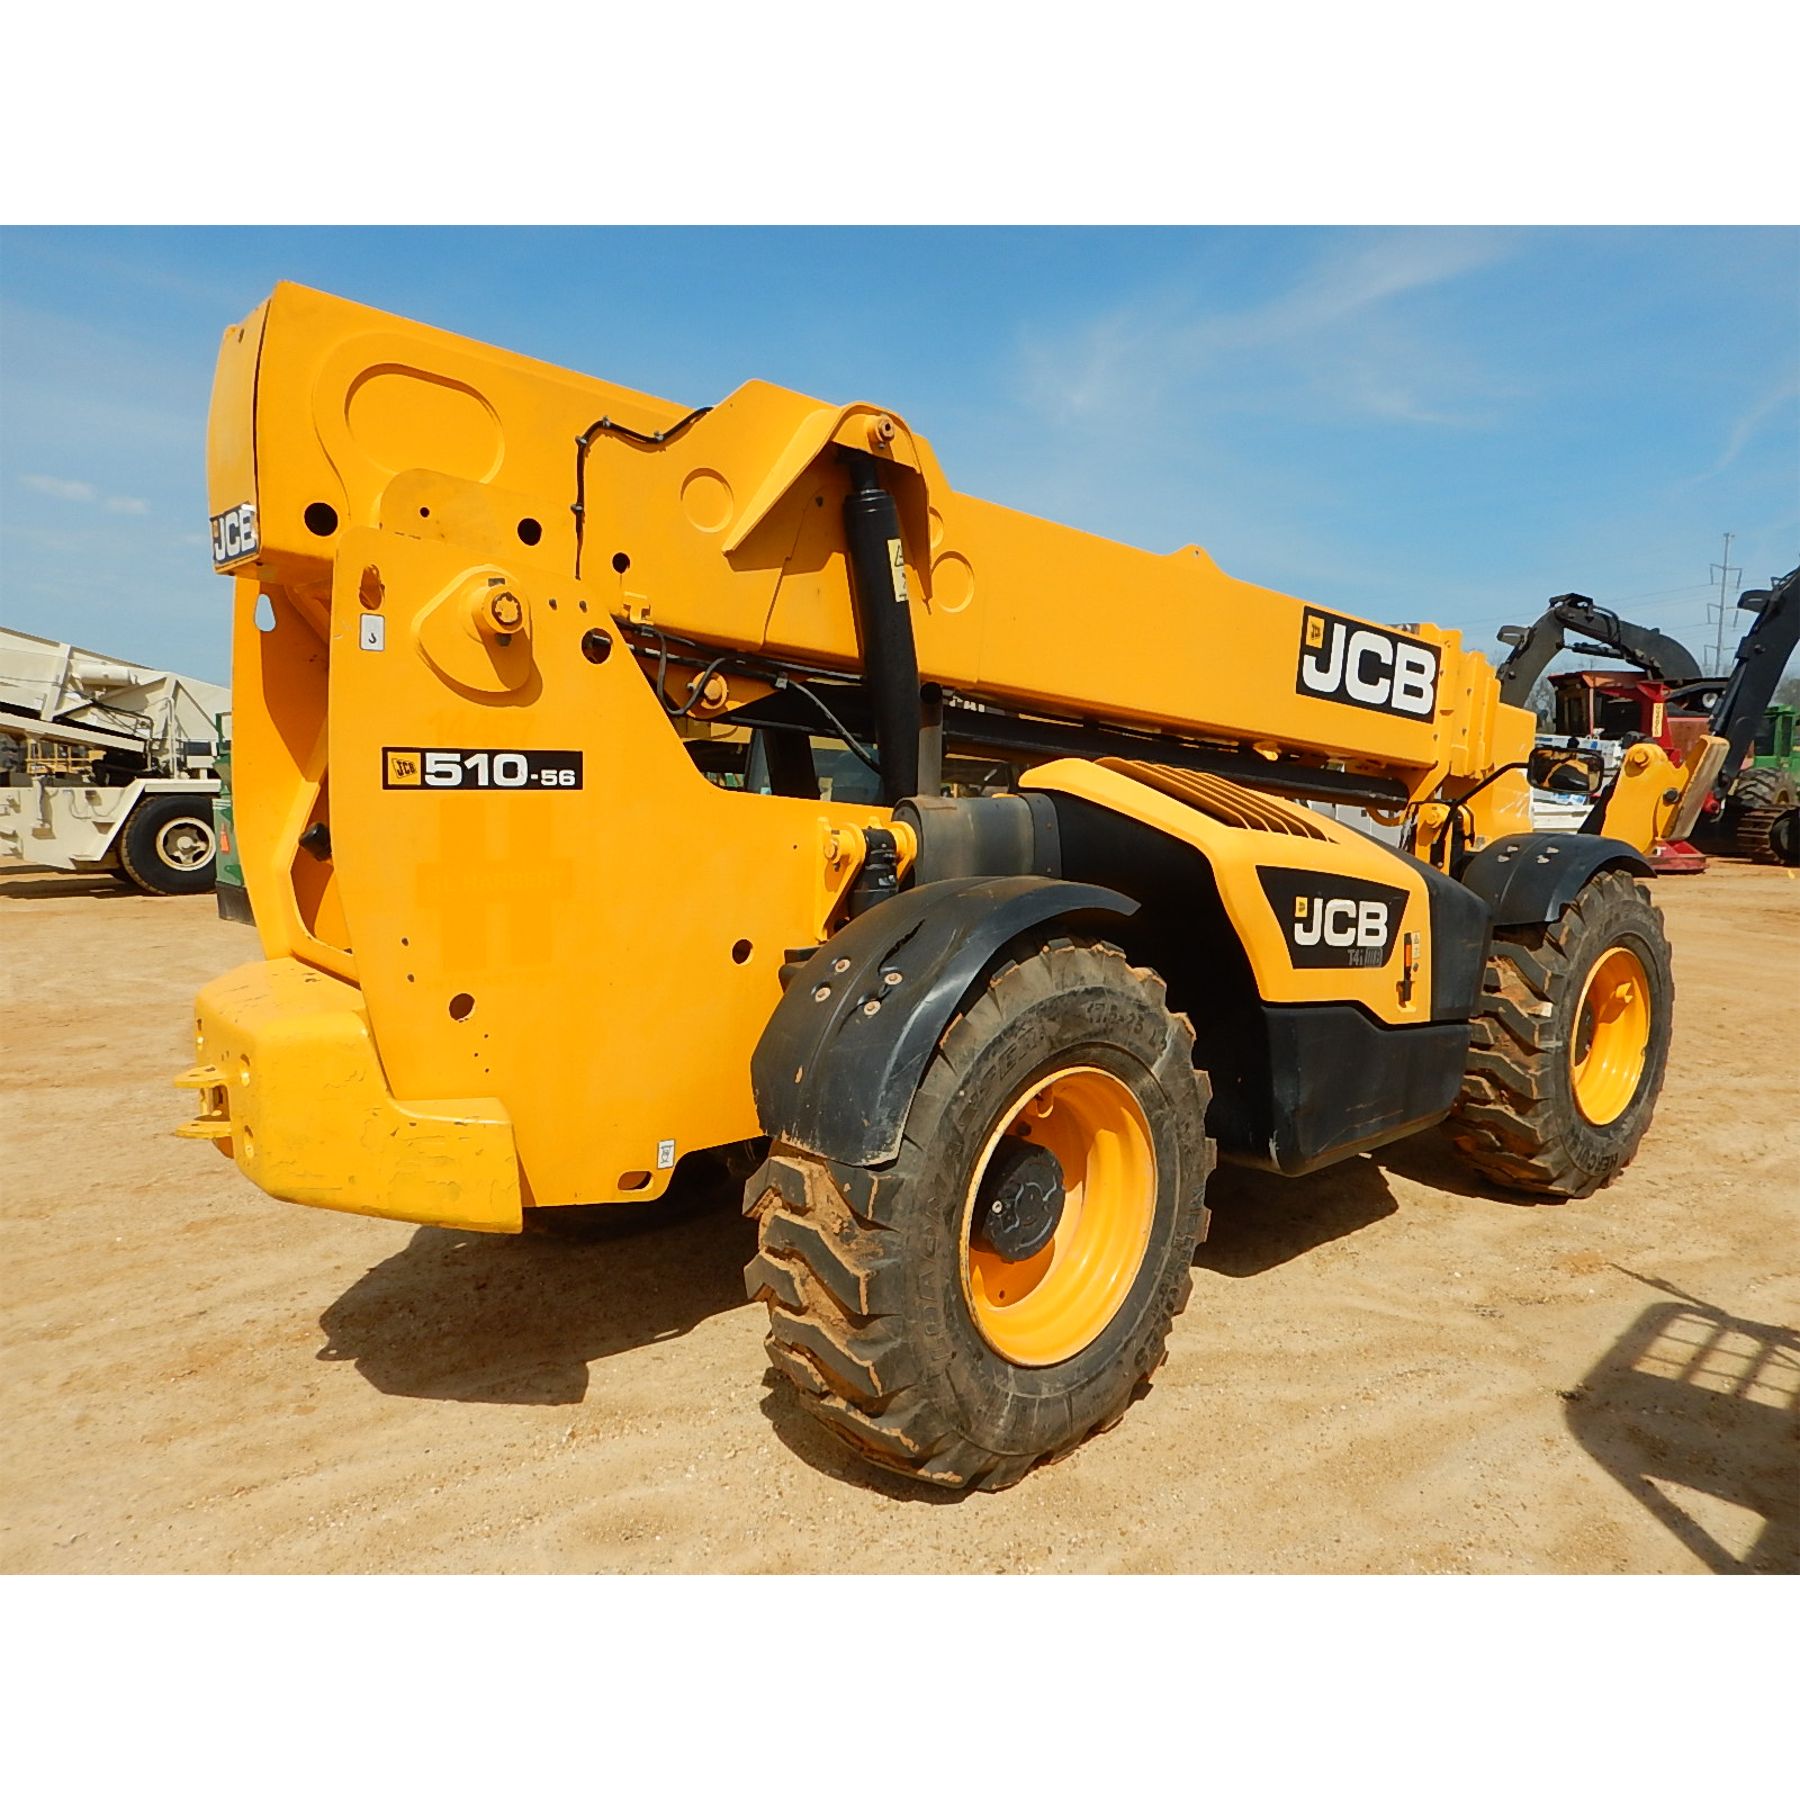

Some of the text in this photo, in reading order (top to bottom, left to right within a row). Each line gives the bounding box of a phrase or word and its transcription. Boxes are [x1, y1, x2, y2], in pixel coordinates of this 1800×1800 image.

[214, 508, 256, 561] JCB
[1302, 623, 1436, 716] JCB
[396, 758, 417, 777] JCB
[1294, 898, 1388, 947] JCB
